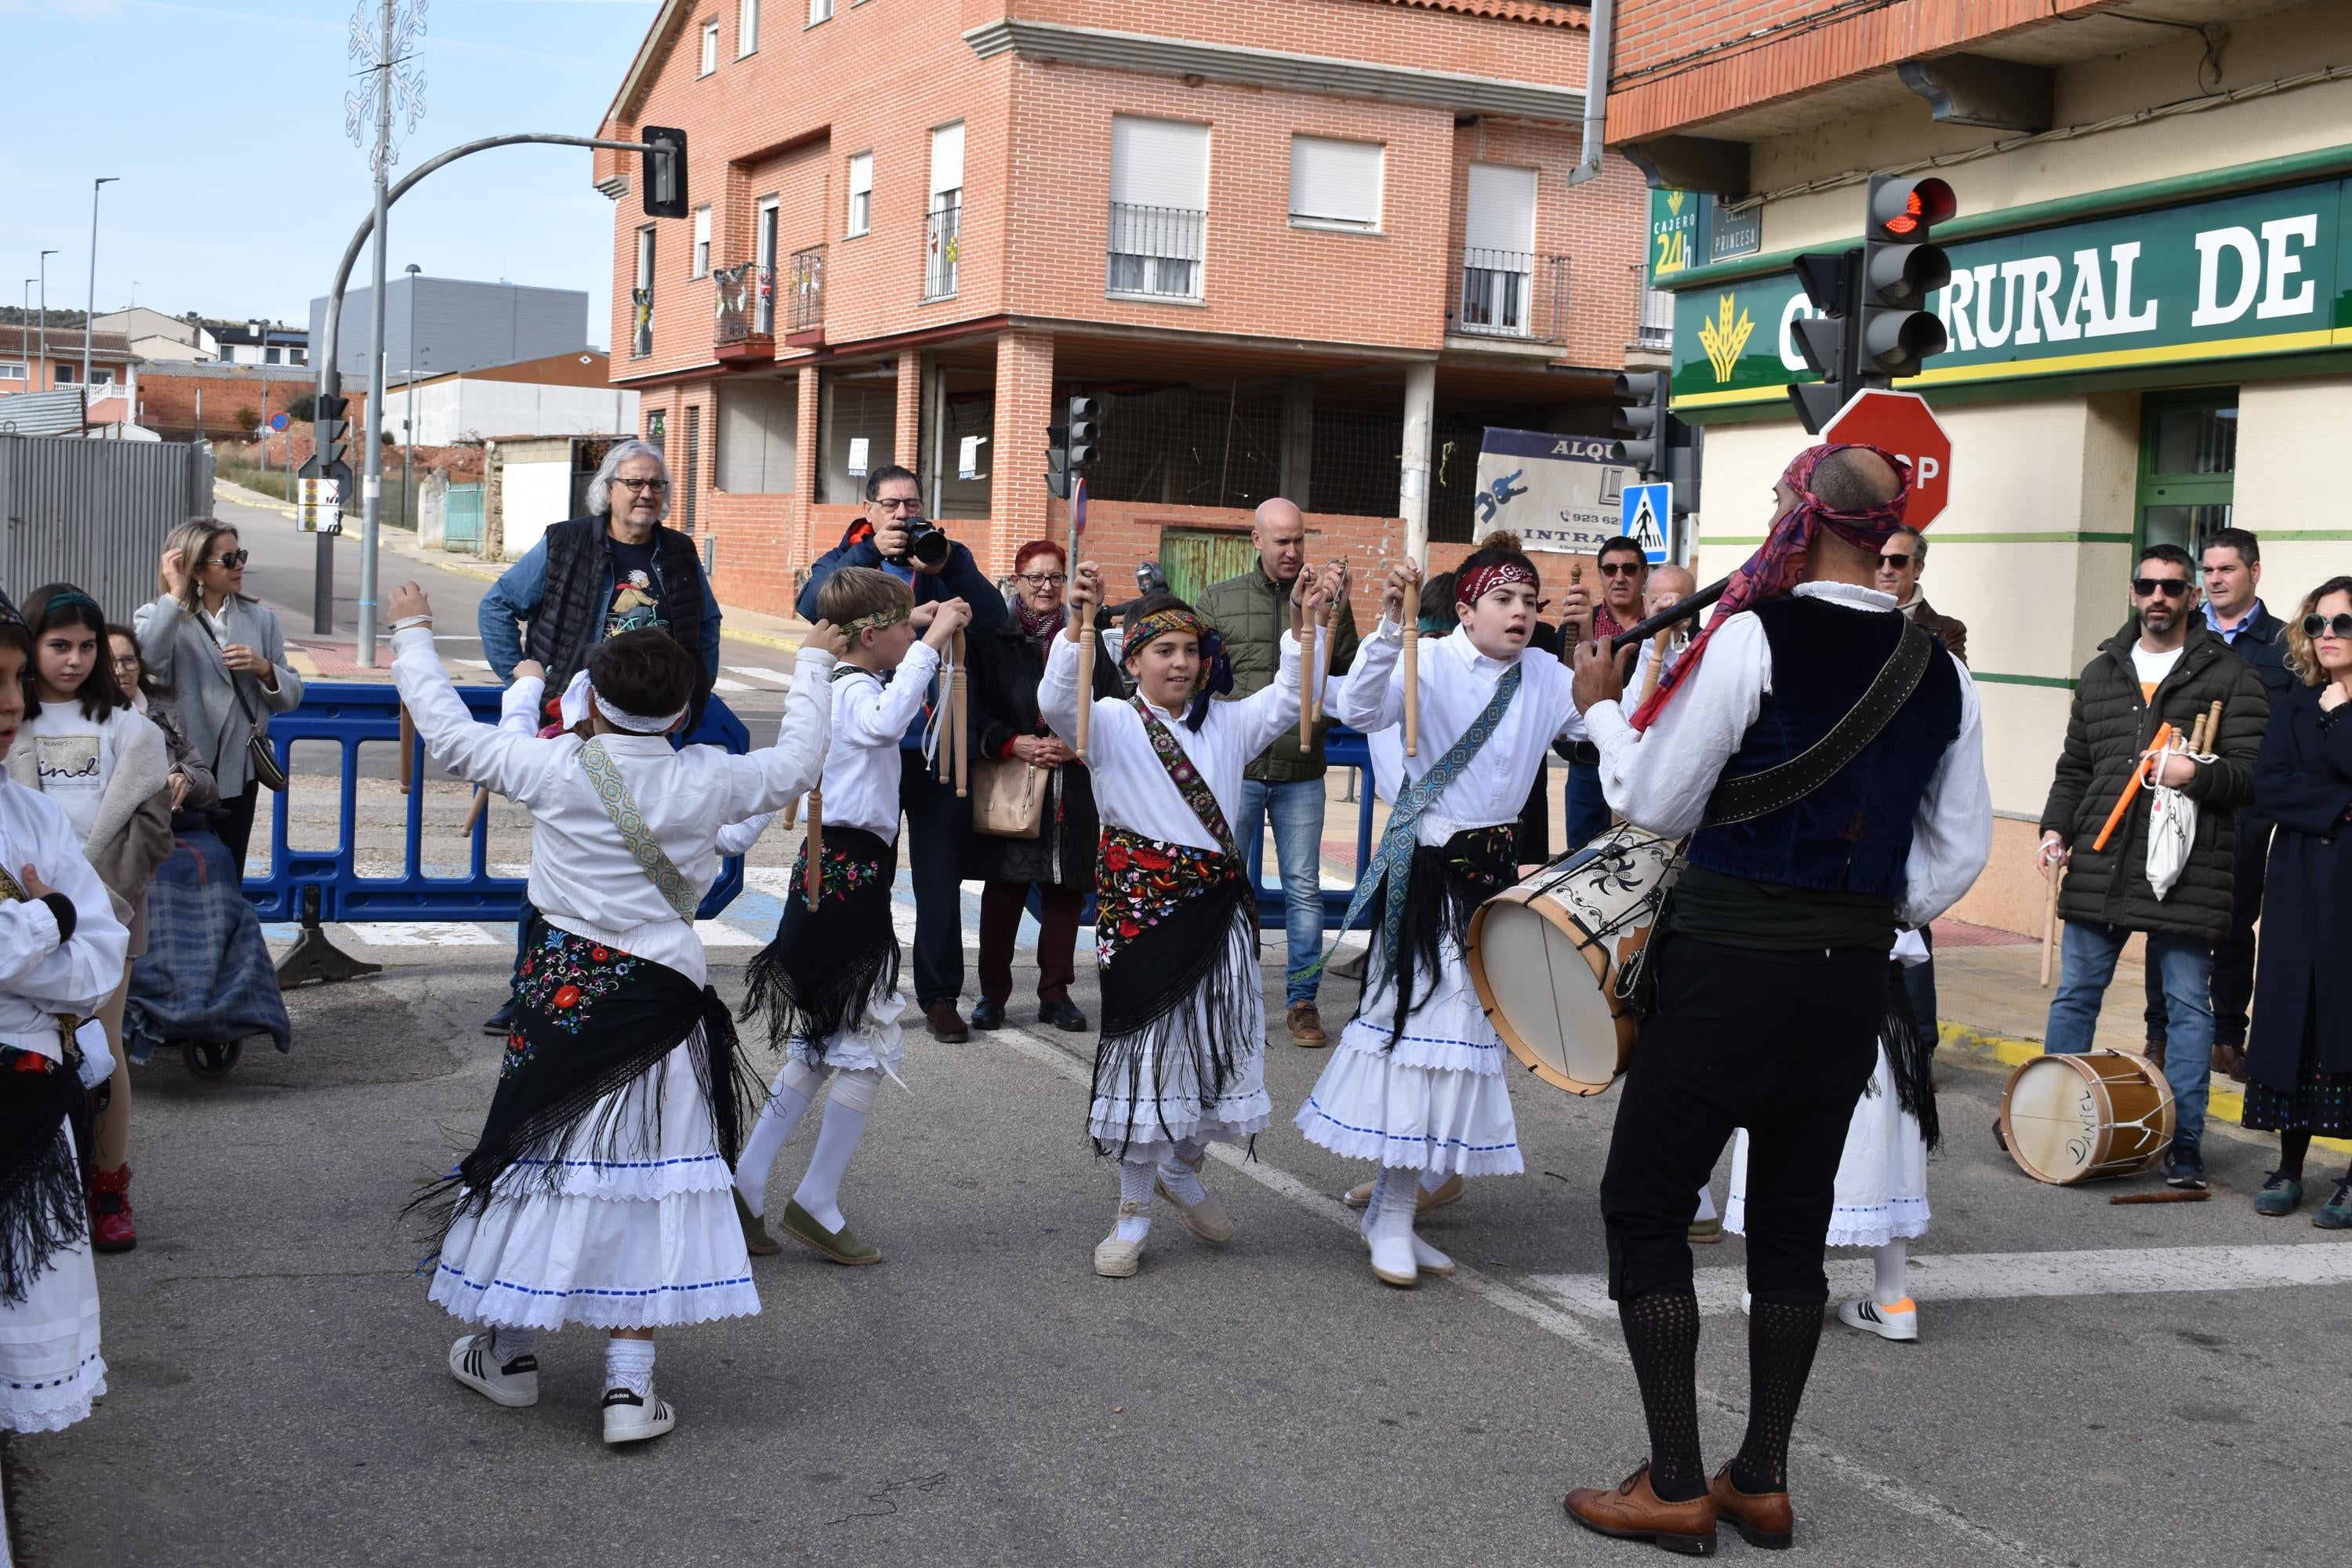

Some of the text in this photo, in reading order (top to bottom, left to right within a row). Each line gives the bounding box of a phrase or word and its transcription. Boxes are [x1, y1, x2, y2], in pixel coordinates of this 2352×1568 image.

[1654, 214, 1695, 234] CAJERO
[1715, 228, 1755, 252] PRINCESA
[1656, 230, 1692, 274] 24h
[1939, 241, 2158, 353] RURAL
[2191, 213, 2318, 327] DE
[1573, 514, 1621, 525] 923 62
[38, 757, 100, 779] ind
